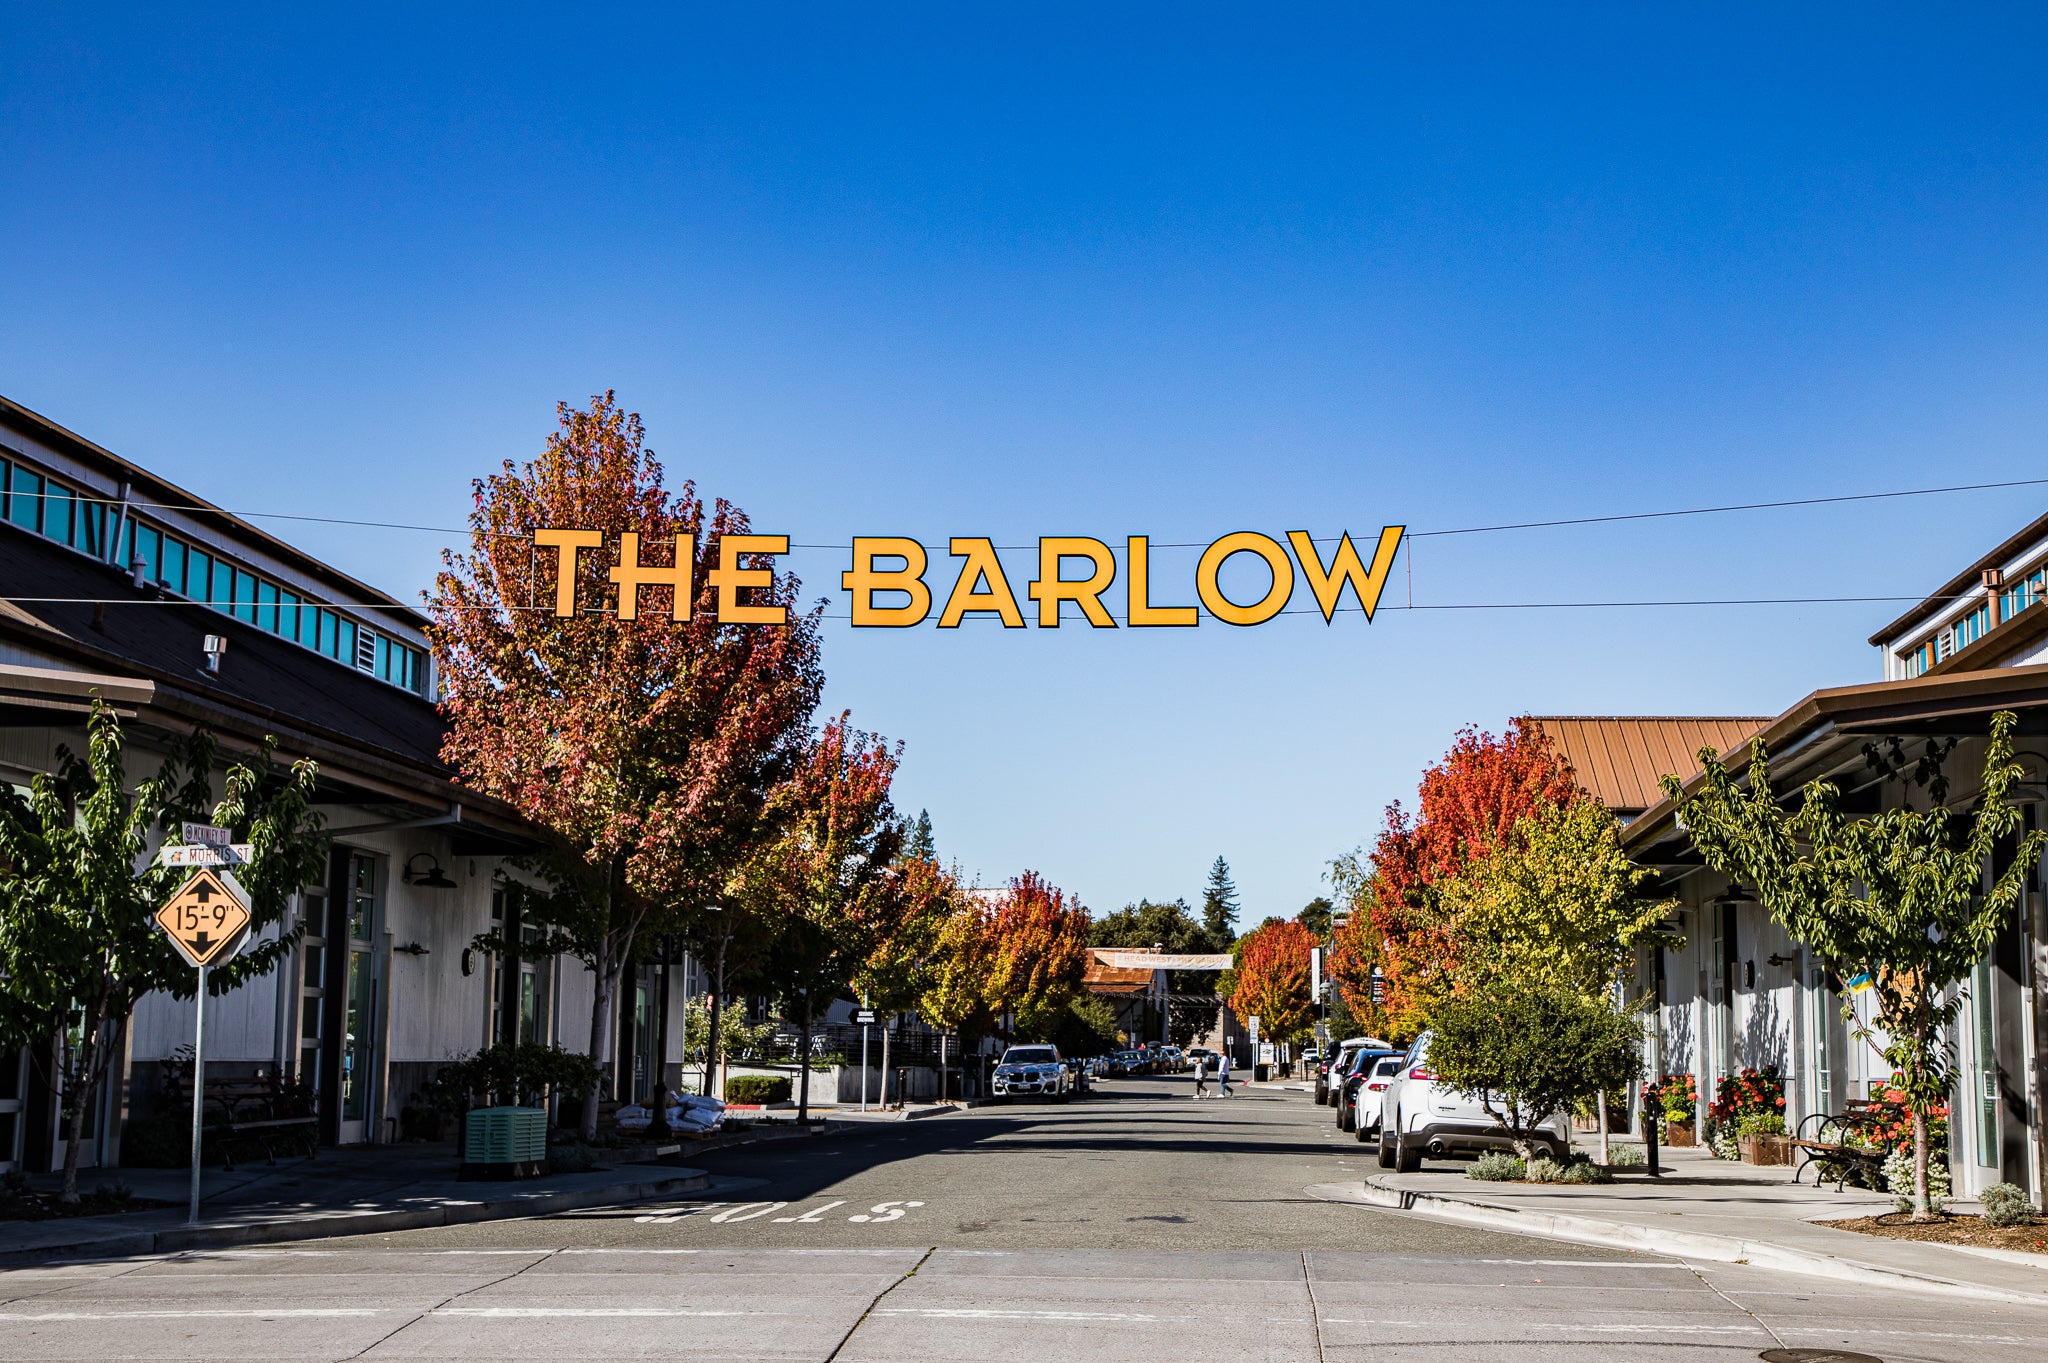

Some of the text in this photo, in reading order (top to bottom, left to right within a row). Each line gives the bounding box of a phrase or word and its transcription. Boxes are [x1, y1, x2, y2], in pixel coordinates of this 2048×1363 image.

[534, 525, 1406, 629] THE BARLOW
[220, 830, 226, 844] ST
[190, 847, 249, 862] MORRIS ST
[633, 1200, 926, 1224] STOP
